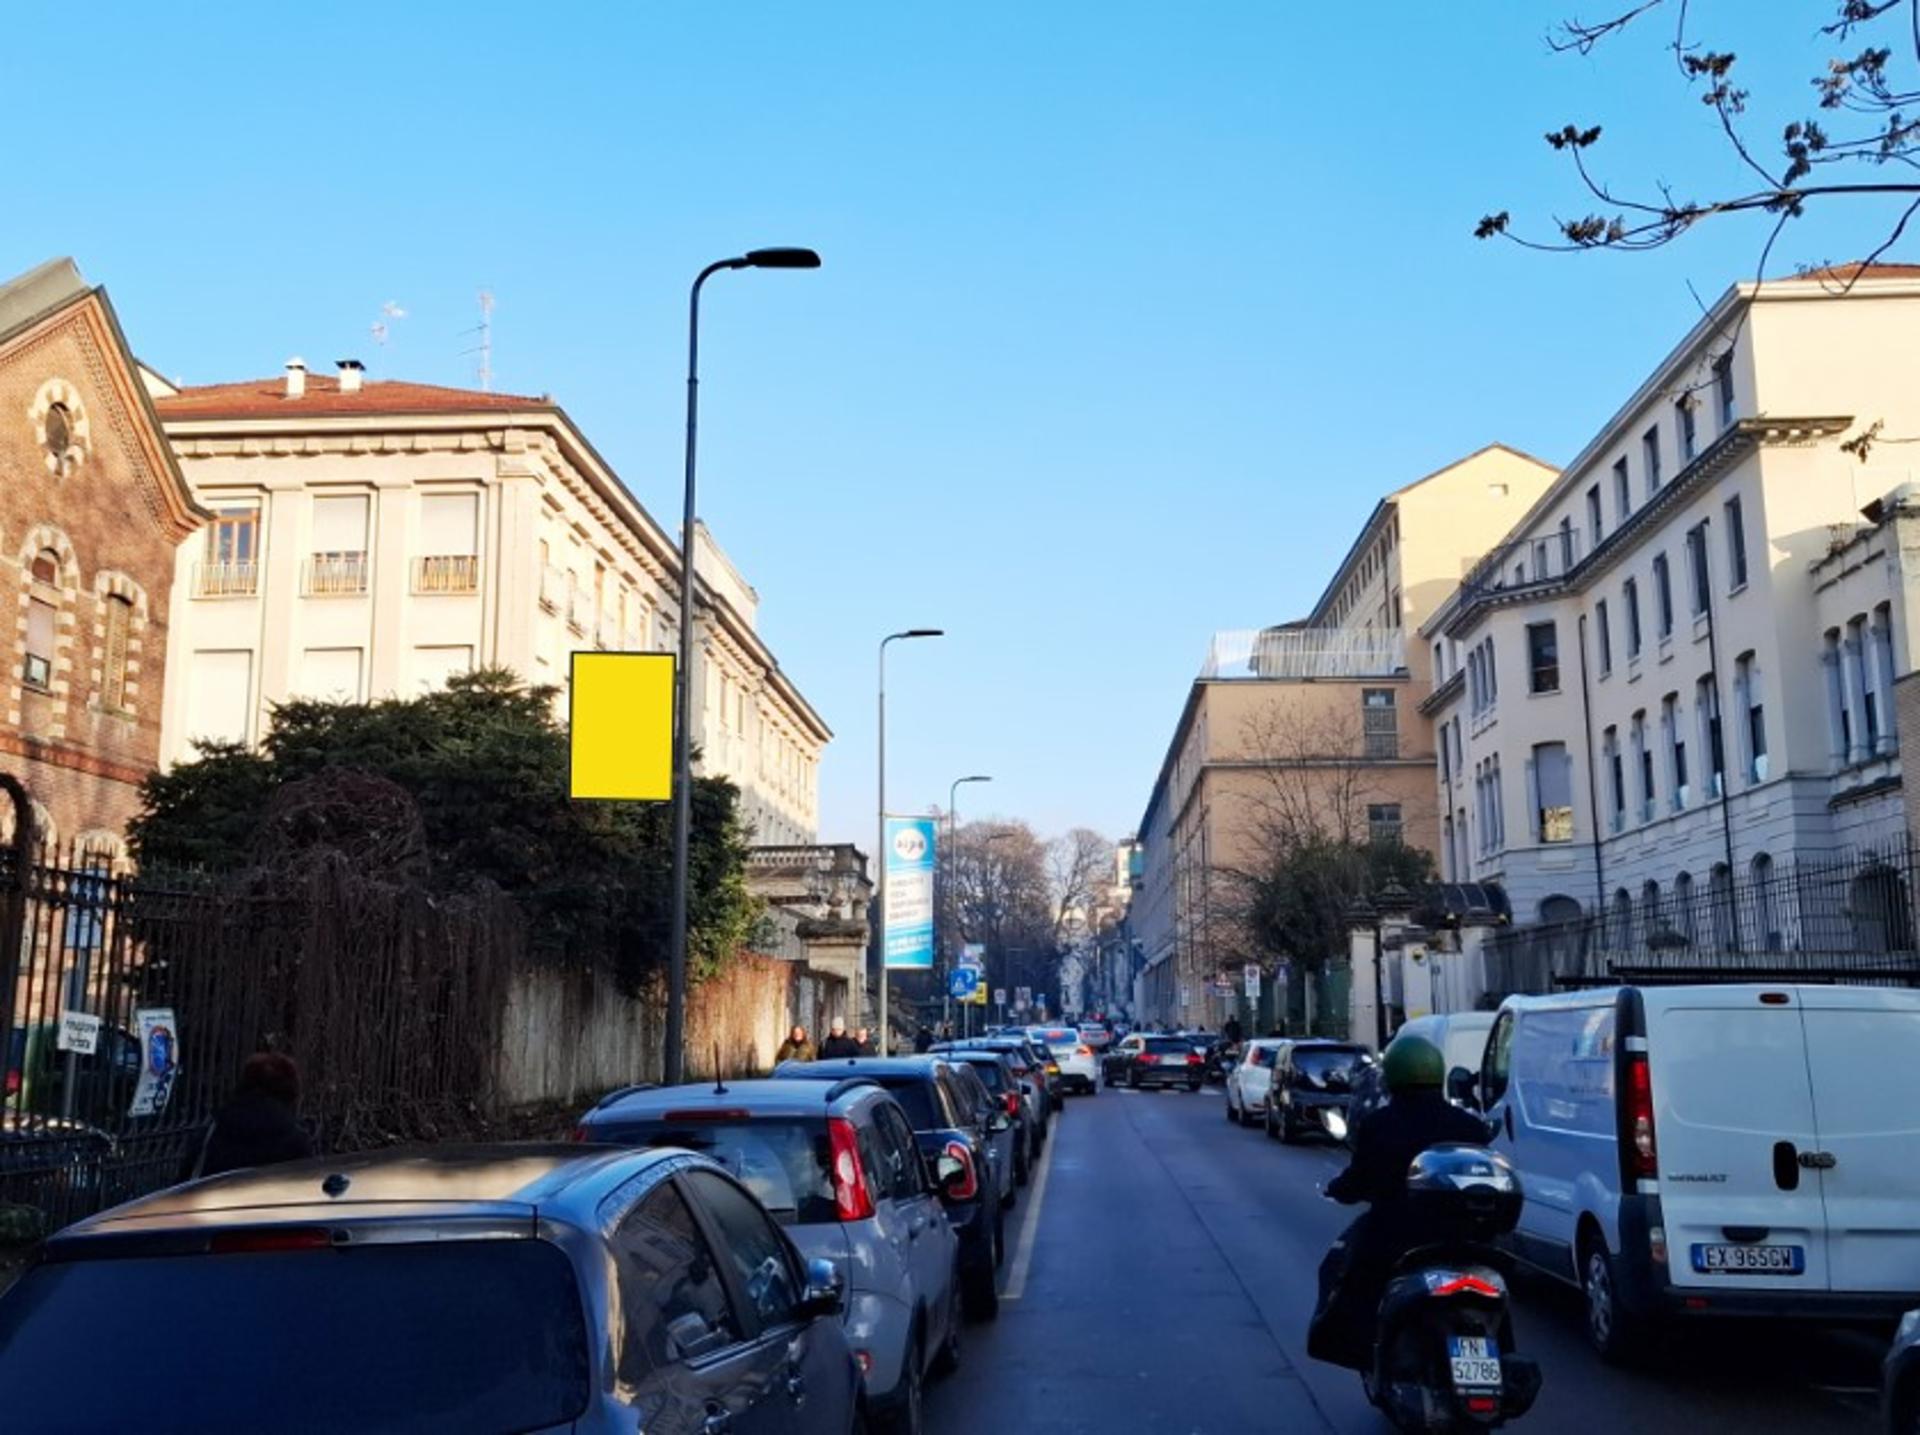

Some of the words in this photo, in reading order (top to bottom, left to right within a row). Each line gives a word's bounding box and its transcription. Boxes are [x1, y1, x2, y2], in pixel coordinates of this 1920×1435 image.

[1706, 1249, 1731, 1267] EX
[1734, 1248, 1792, 1268] 965GW
[1460, 1338, 1480, 1357] FN
[1455, 1361, 1500, 1381] 52786
